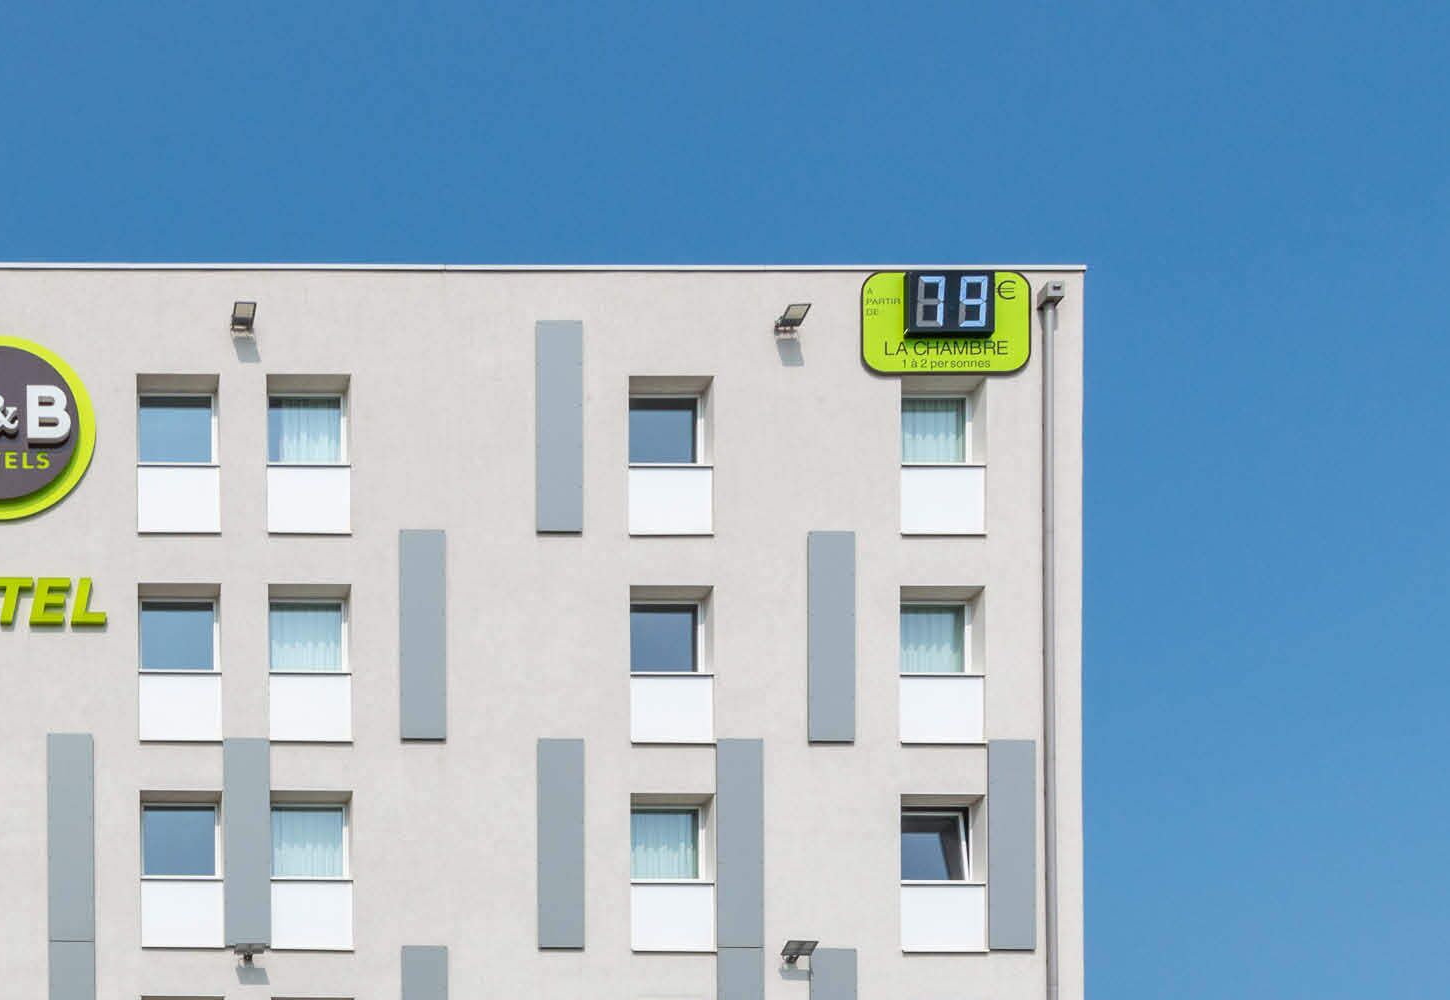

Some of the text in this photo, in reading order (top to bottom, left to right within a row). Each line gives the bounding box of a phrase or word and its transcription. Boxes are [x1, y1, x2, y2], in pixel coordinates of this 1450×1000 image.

[866, 297, 901, 305] PARTIR
[866, 308, 879, 316] DE
[884, 340, 1009, 356] LA CHAMBRE
[911, 359, 918, 368] à
[920, 359, 927, 368] 2
